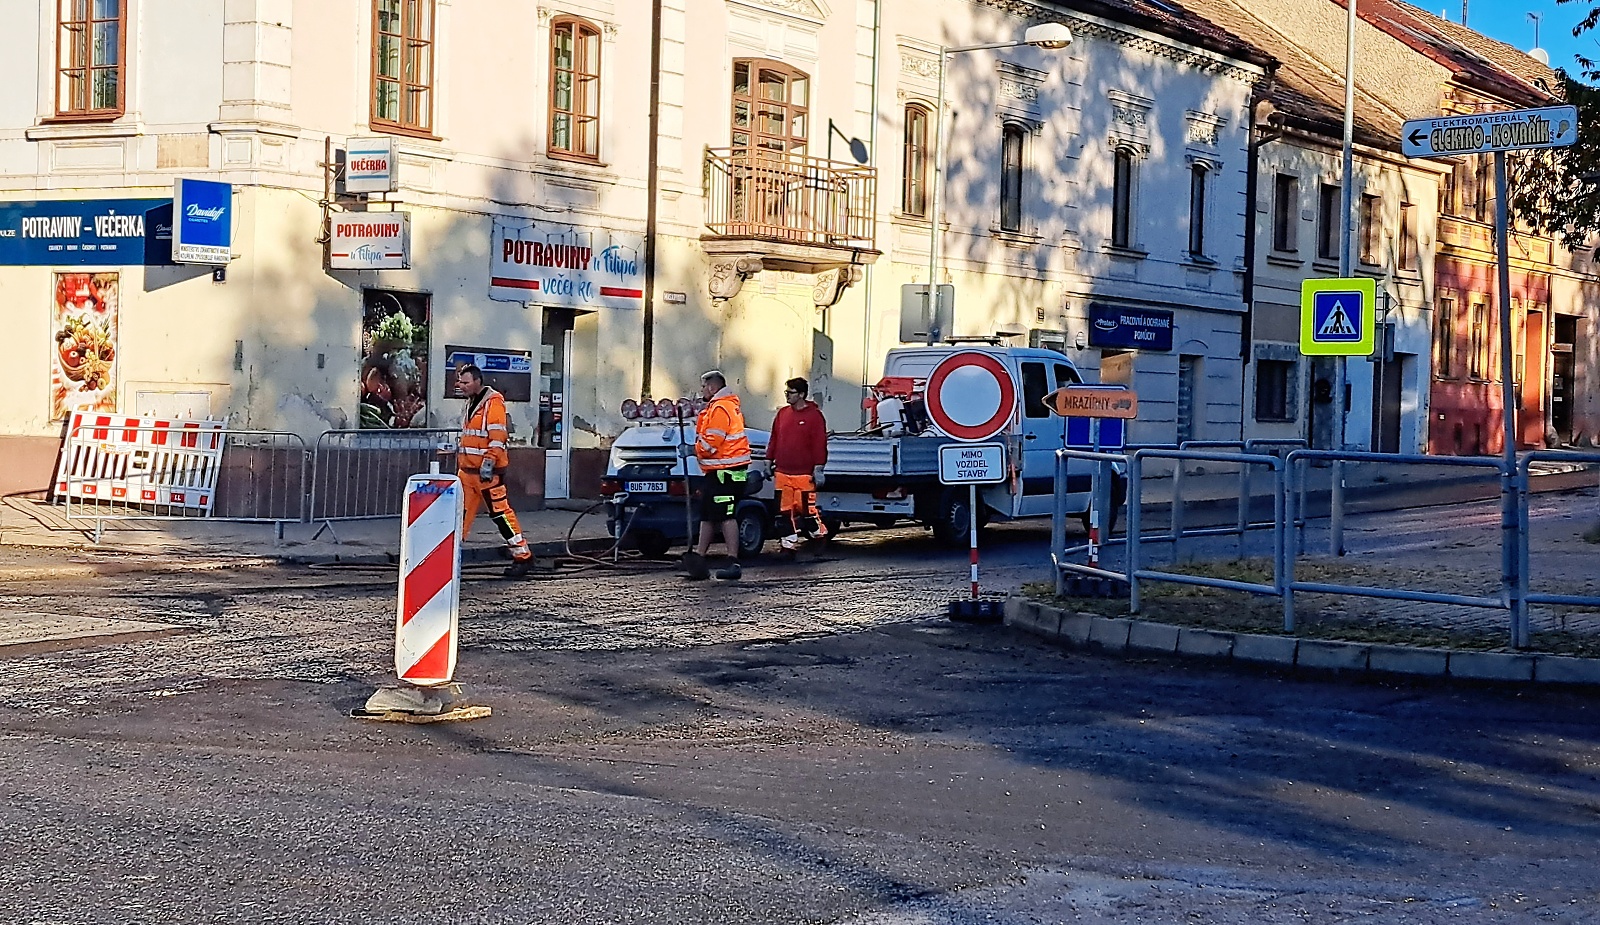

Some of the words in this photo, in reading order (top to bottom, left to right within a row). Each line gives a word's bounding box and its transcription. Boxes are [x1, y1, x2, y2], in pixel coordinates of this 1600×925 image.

[1431, 114, 1523, 128] ELEKTROMATERIÁL
[1430, 126, 1484, 152] ELEKTRO
[1491, 114, 1550, 147] KOVAŘÍK
[350, 158, 388, 171] VEČERKA
[186, 203, 226, 221] Davidoff
[0, 229, 16, 237] ULZE
[22, 216, 82, 238] POTRAVINY
[94, 209, 145, 237] VEČERKA
[336, 223, 399, 238] POTRAVINY
[350, 252, 356, 261] u
[356, 244, 383, 264] Filipa
[503, 238, 591, 271] POTRAVINY
[593, 256, 600, 272] u
[600, 245, 637, 283] Filipa
[216, 270, 221, 280] 2
[1064, 394, 1110, 410] MRAZÍRNY
[961, 451, 983, 459] MIMO
[956, 460, 988, 468] VOZIDEL
[957, 469, 988, 478] STAVBY
[630, 482, 643, 491] 8U6
[646, 482, 664, 491] 7863
